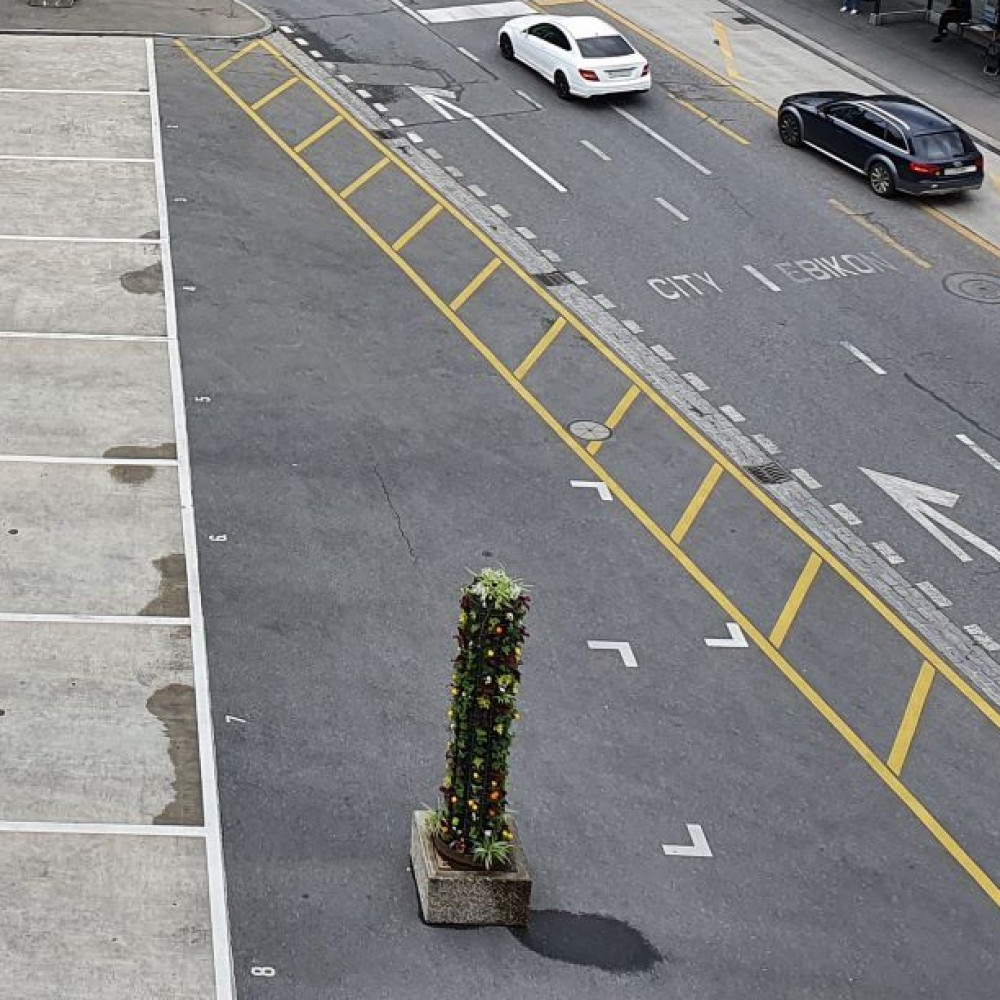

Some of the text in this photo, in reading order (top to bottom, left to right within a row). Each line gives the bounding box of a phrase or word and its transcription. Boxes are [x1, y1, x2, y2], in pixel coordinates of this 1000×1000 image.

[774, 250, 903, 284] EBIKON
[646, 270, 725, 301] CITY
[208, 533, 228, 542] 6
[224, 714, 248, 725] 7
[250, 966, 276, 977] 8
